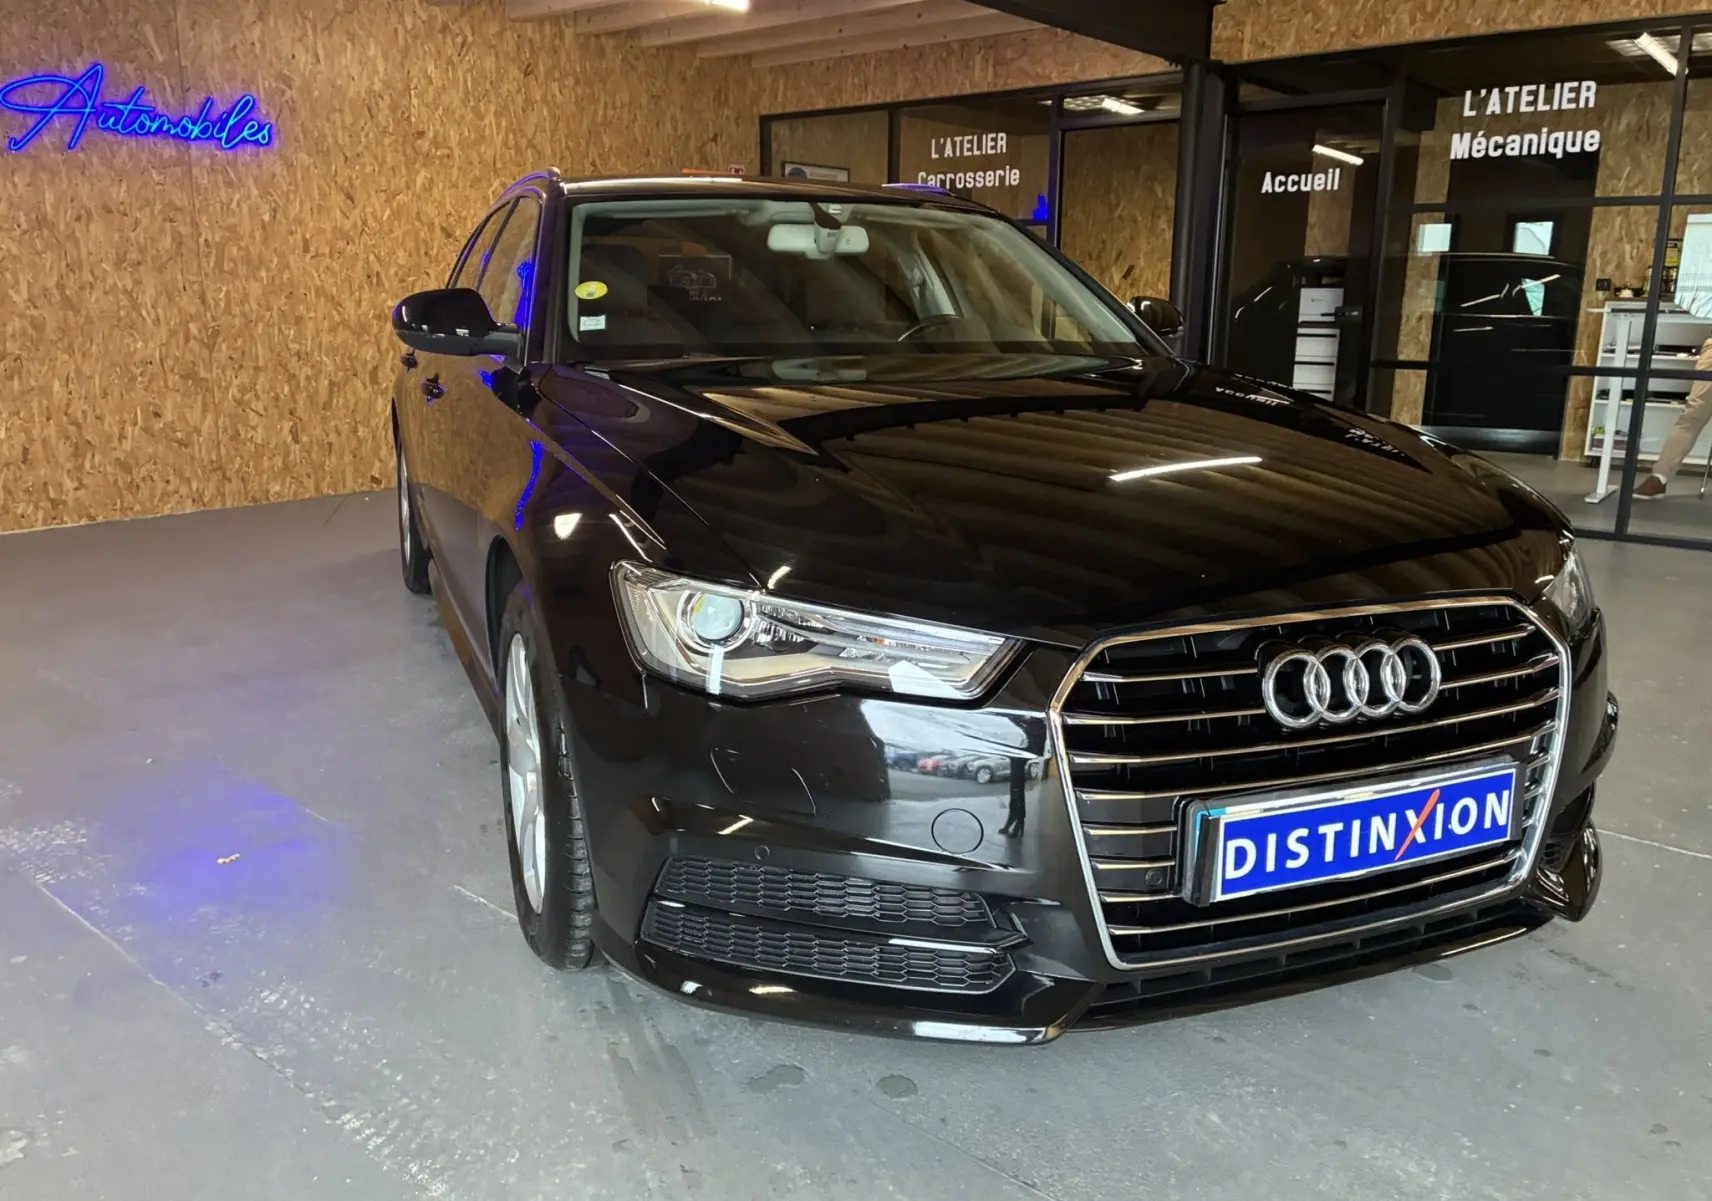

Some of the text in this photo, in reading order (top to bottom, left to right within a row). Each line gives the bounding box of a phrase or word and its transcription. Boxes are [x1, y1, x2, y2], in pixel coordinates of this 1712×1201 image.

[0, 63, 273, 150] Automobiles
[1463, 81, 1597, 117] L'ATELIER
[931, 132, 1007, 158] L'ATELIER
[1450, 124, 1601, 161] Mécanique
[918, 165, 1020, 190] Carrosserie
[1260, 167, 1341, 195] Accueil
[1225, 789, 1509, 880] DISTINXION
